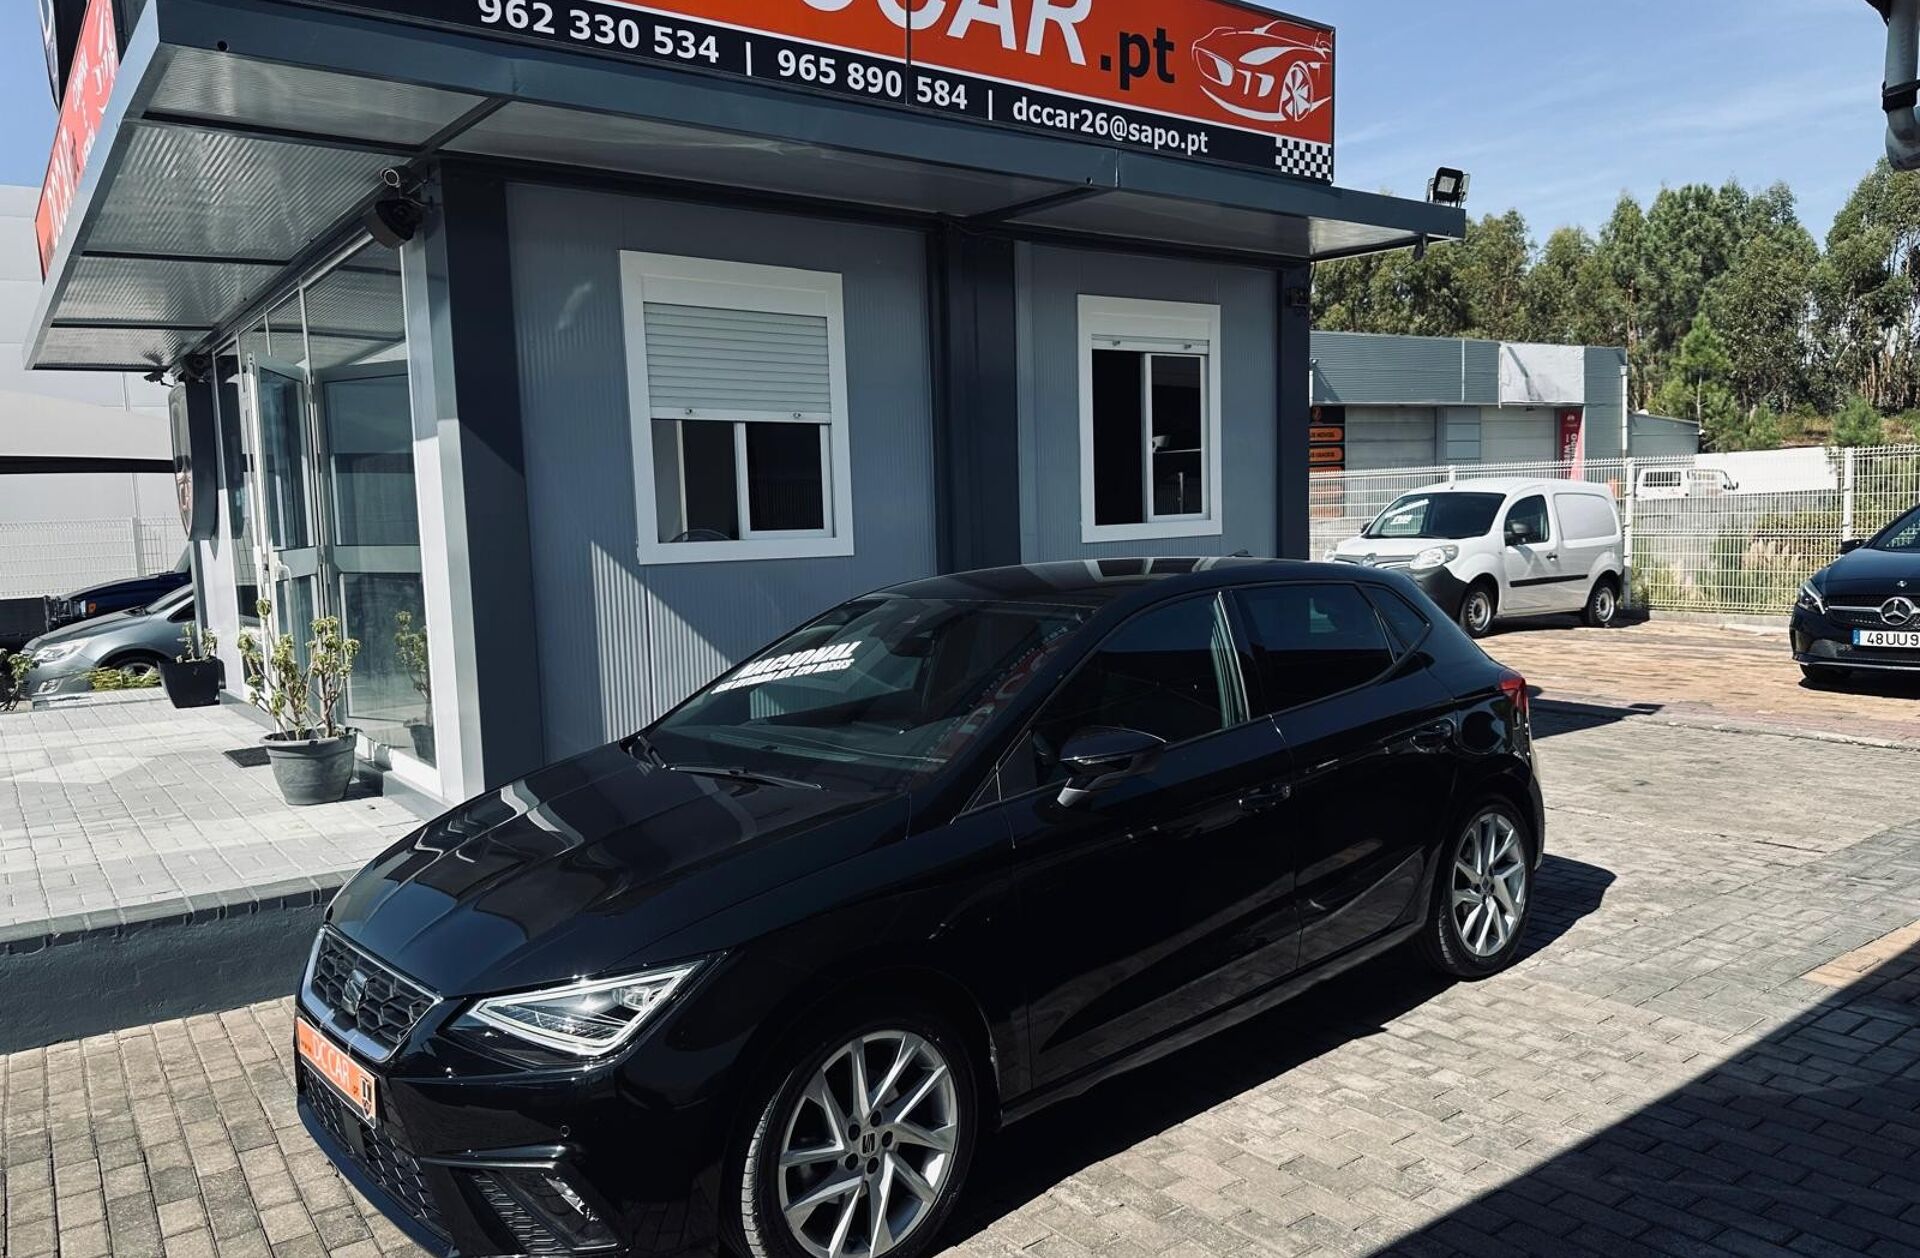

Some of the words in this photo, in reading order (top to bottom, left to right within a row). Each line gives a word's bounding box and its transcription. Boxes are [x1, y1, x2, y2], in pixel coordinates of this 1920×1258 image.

[478, 0, 555, 35] 962
[569, 10, 640, 49] 330
[654, 26, 720, 64] 534
[777, 50, 836, 84] 965
[847, 63, 902, 98] 890
[917, 77, 968, 110] 584
[1012, 96, 1208, 156] dccar26@sapo.pt
[732, 640, 862, 680] NACIONAL
